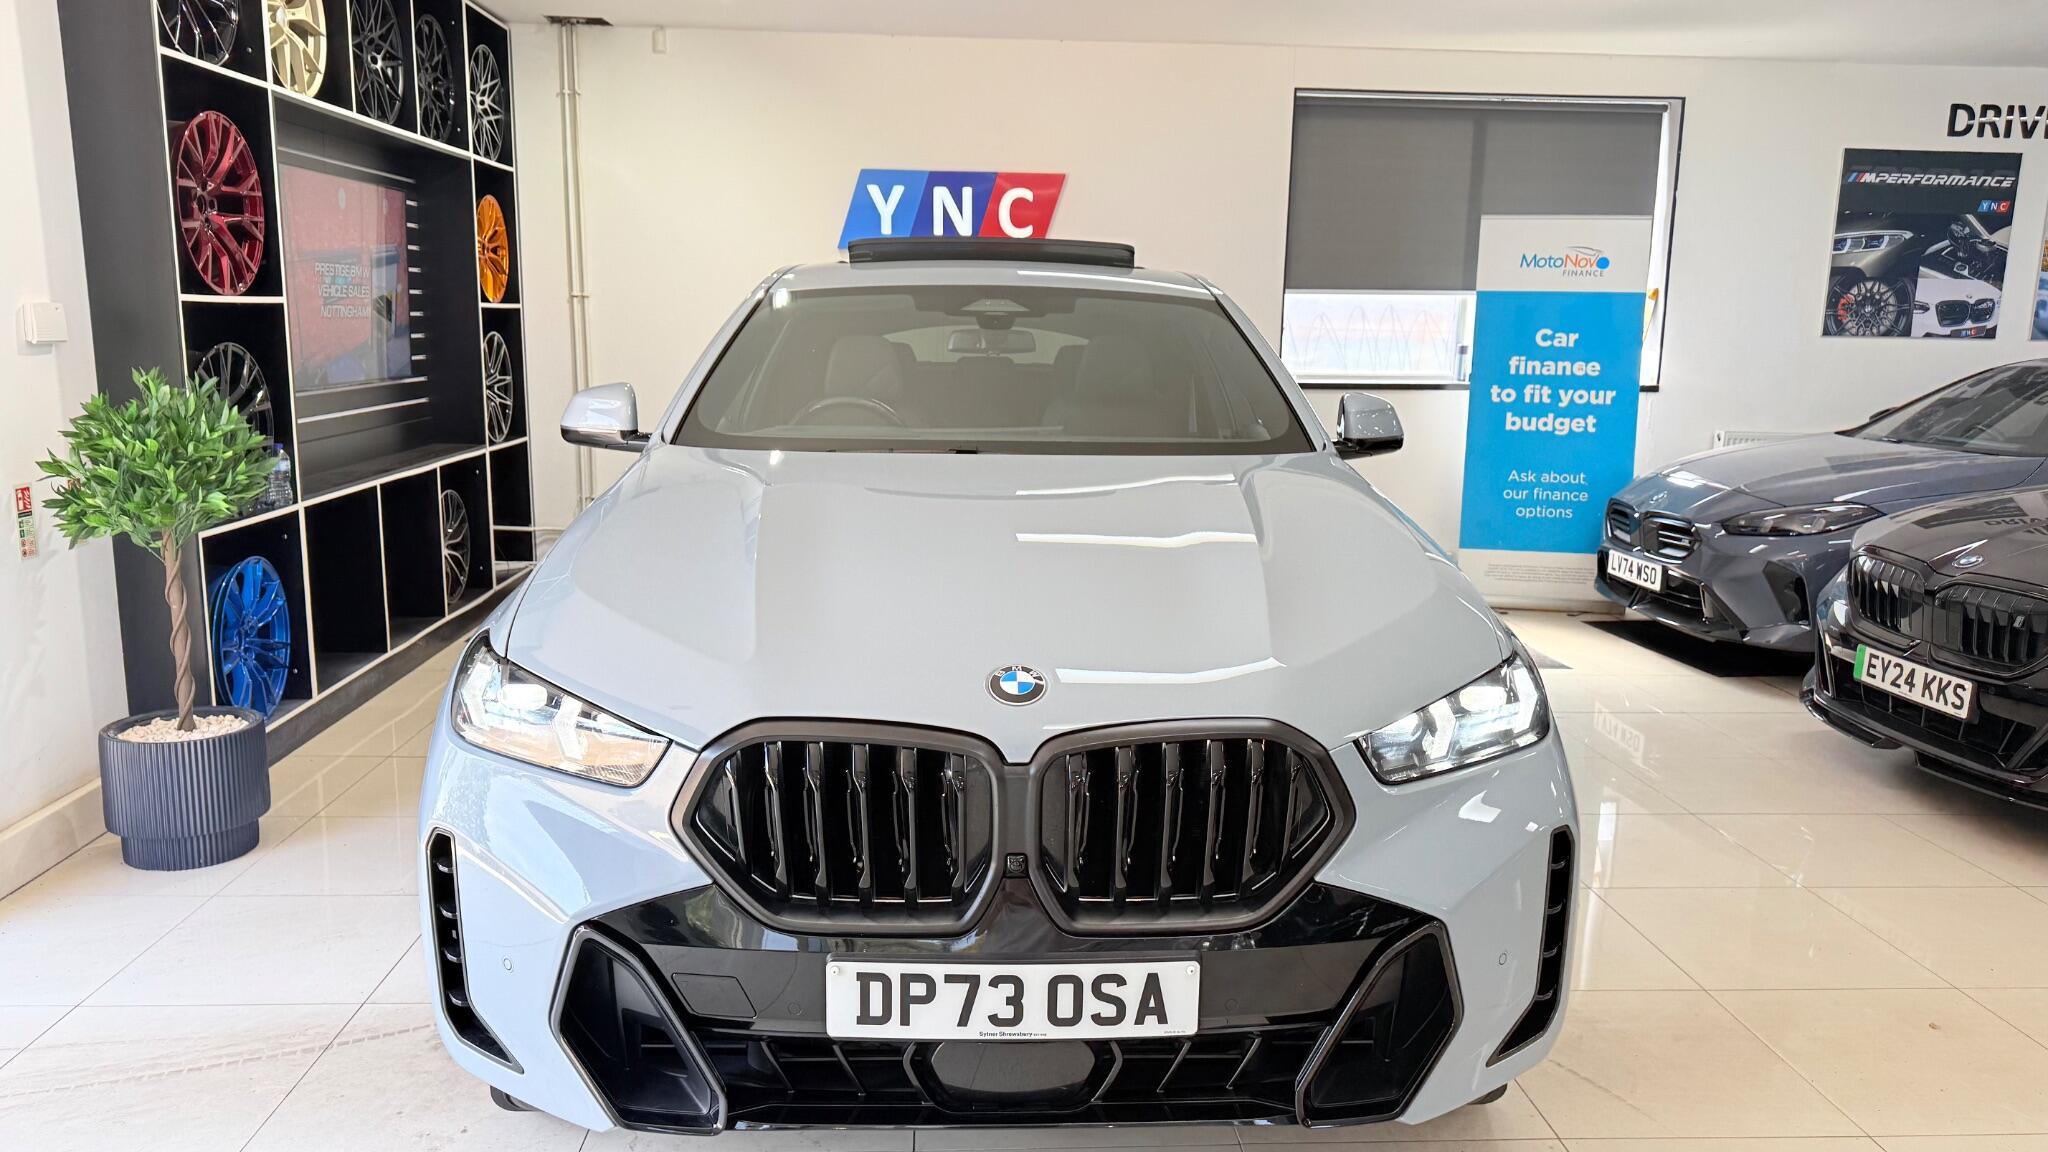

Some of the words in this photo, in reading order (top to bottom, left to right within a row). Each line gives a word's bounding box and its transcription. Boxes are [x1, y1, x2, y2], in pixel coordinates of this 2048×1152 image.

[1946, 103, 2048, 140] DRIV
[866, 184, 1034, 239] YNC
[1981, 202, 2009, 212] YNC
[1562, 269, 1605, 278] FINANCE
[1535, 328, 1580, 348] Car
[1509, 355, 1601, 376] finance
[1490, 385, 1517, 403] to
[1524, 384, 1552, 404] fit
[1558, 388, 1617, 408] your
[1505, 411, 1597, 436] budget
[1508, 469, 1536, 483] Ask
[1540, 471, 1587, 485] about
[1503, 488, 1528, 500] our
[1533, 487, 1589, 502] finance
[1515, 505, 1573, 519] options
[1611, 553, 1634, 577] LV74
[1636, 562, 1658, 586] WSO
[1866, 653, 1916, 693] EY24
[1921, 671, 1967, 711] KKS
[856, 971, 1025, 1028] DP73
[1047, 972, 1169, 1027] OSA
